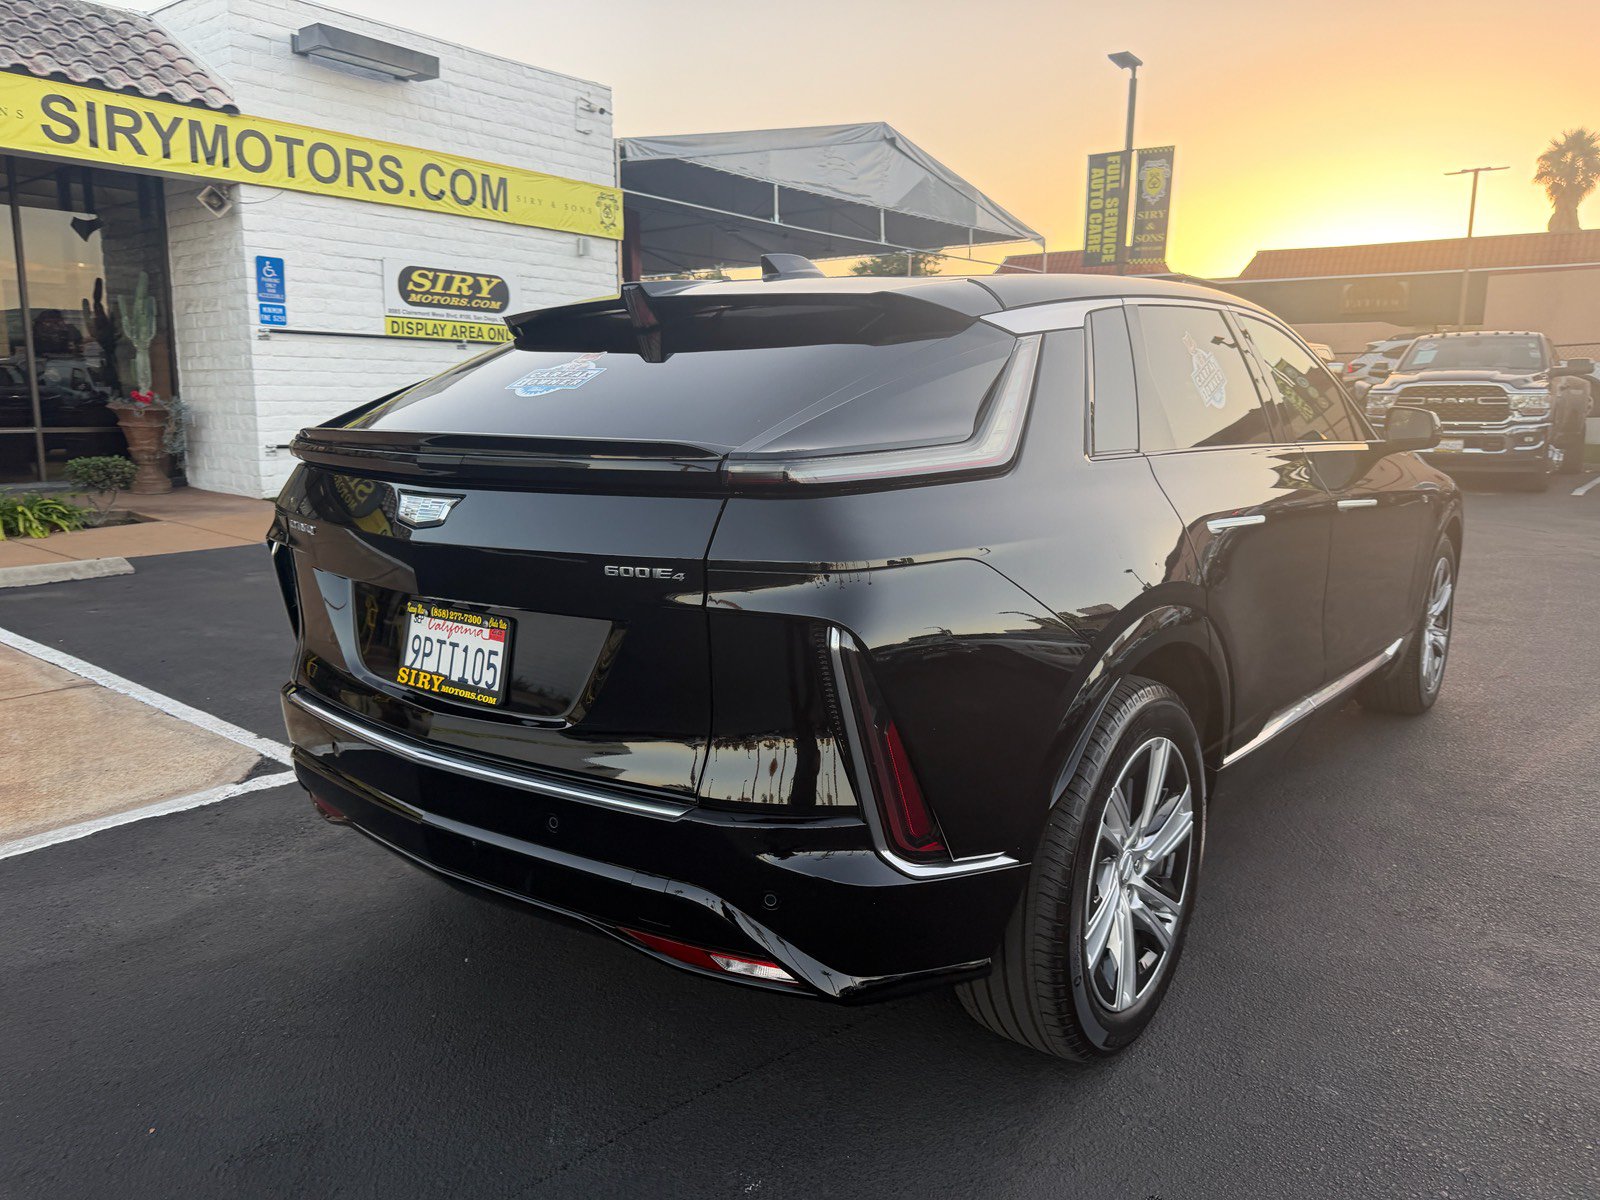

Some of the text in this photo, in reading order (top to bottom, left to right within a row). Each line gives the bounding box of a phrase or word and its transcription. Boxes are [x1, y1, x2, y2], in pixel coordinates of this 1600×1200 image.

[41, 93, 509, 213] SIRYMOTORS.COM
[1087, 168, 1105, 253] AUTO CARE
[1101, 155, 1121, 263] FULL SERVICE
[1136, 209, 1167, 220] SIRY
[1146, 222, 1155, 231] &
[1135, 233, 1166, 243] SONS
[406, 269, 502, 298] SIRY
[408, 293, 503, 310] MOTORS.COM
[391, 320, 513, 341] DISPLAY AREA ONL
[431, 607, 449, 619] (858)
[449, 611, 482, 625] 277-7300
[427, 617, 490, 640] California
[397, 667, 445, 692] SIRY
[441, 685, 497, 705] MOTORS.COM
